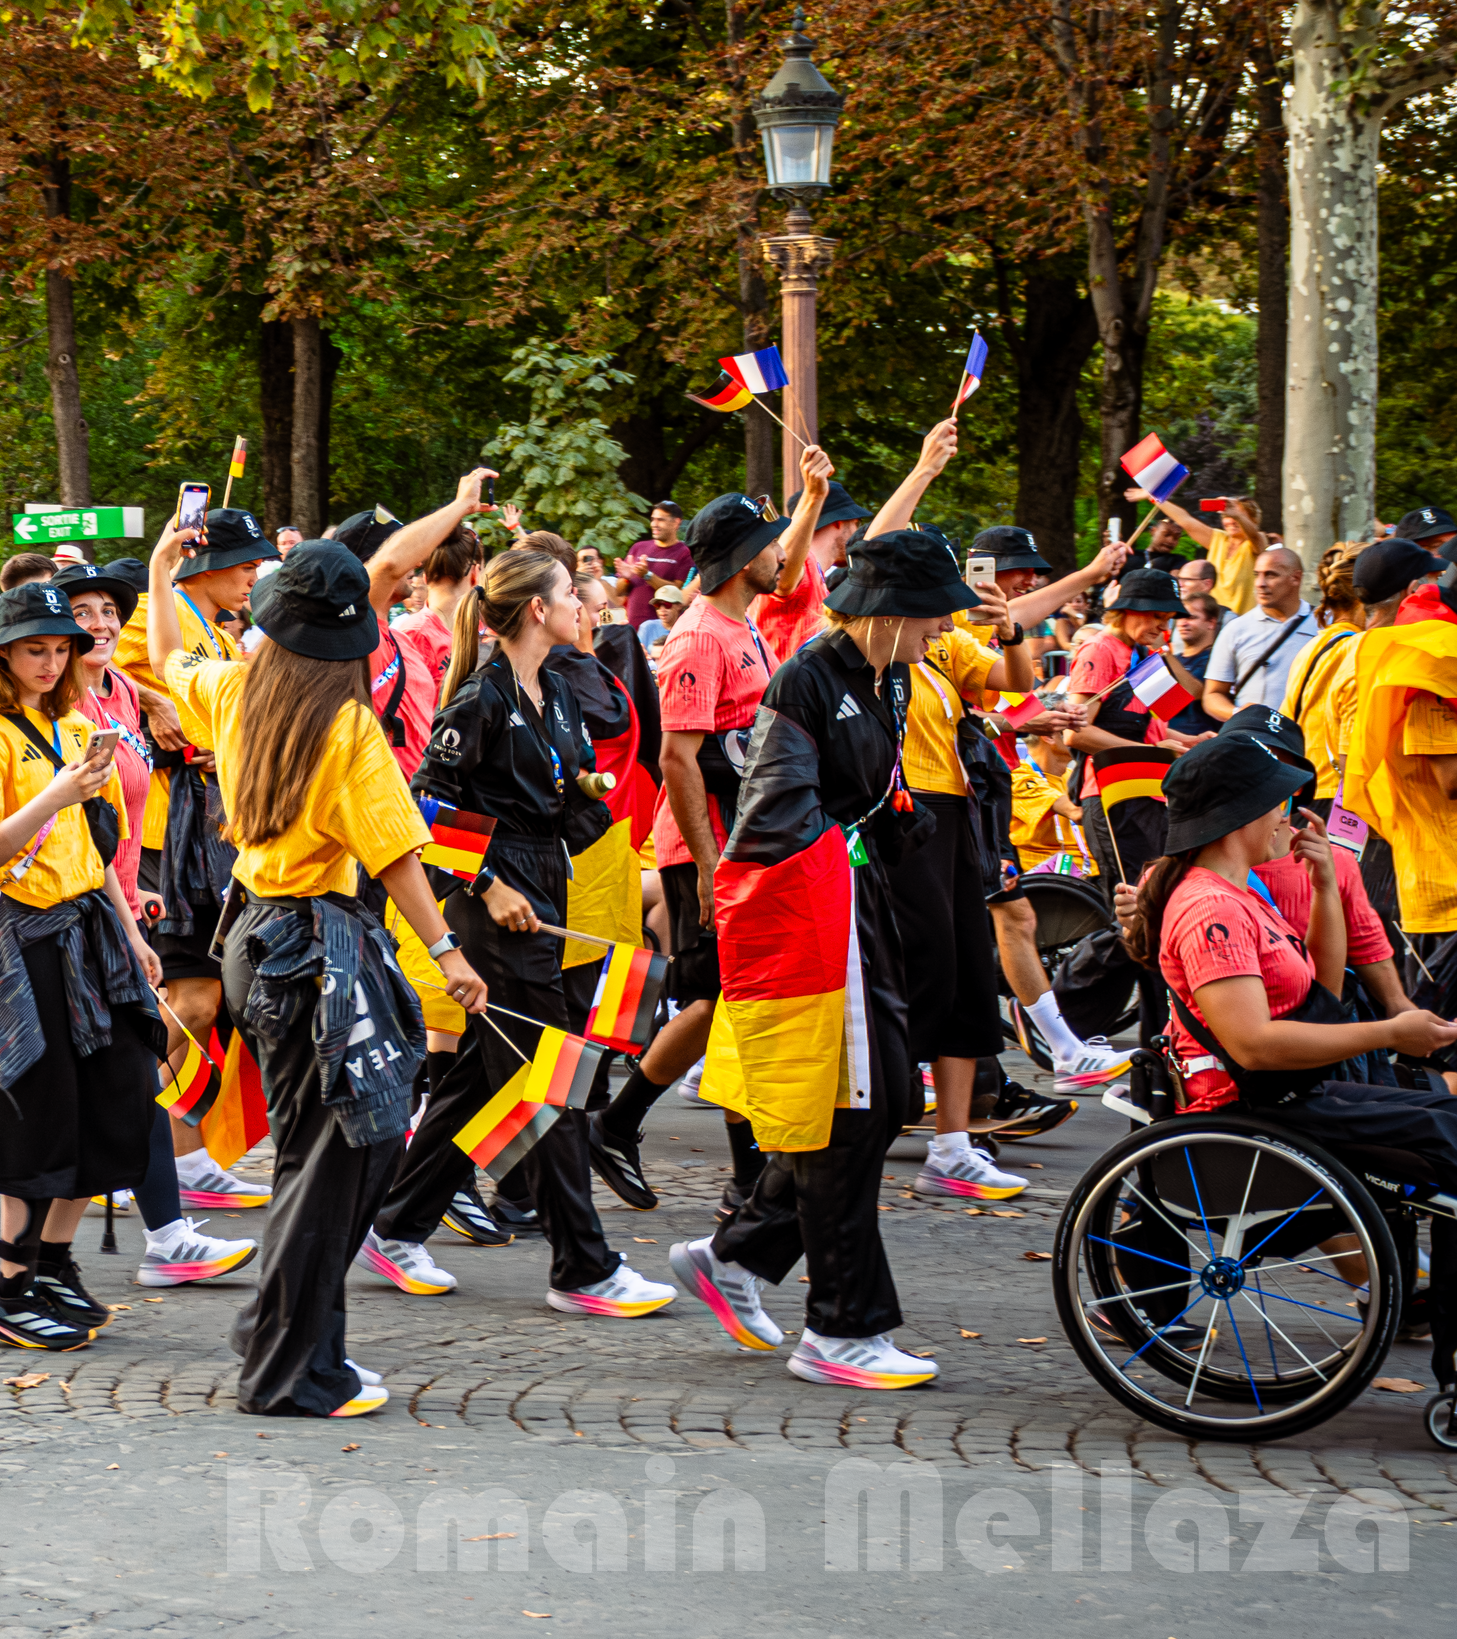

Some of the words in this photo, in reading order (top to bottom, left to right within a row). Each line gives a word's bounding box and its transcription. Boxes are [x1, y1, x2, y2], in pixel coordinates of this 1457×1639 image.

[40, 513, 80, 526] SORTIE
[48, 526, 72, 538] EXIT
[1340, 815, 1359, 828] GER
